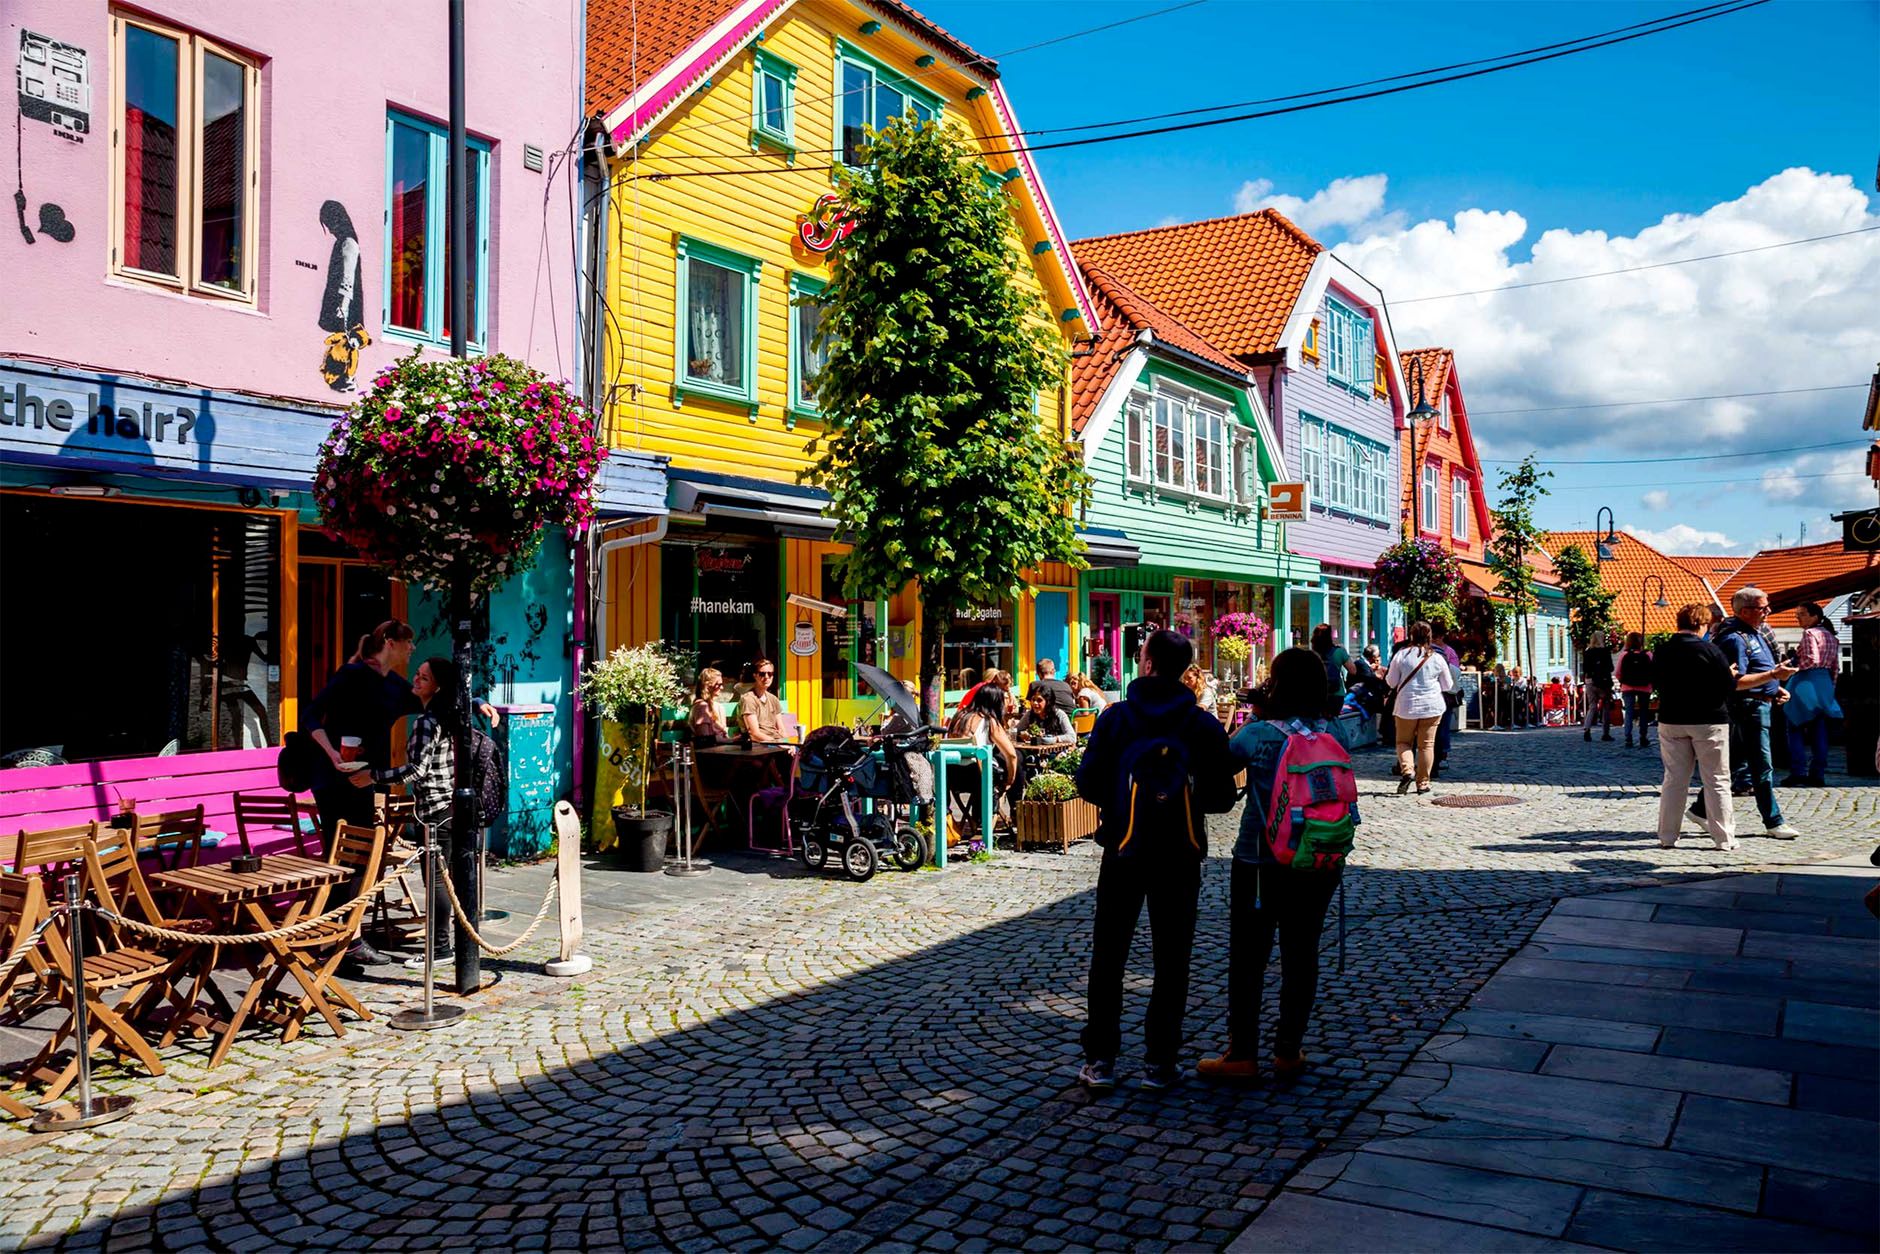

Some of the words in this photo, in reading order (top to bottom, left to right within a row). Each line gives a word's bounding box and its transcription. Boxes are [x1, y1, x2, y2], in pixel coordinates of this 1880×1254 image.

[0, 382, 74, 432] the
[88, 392, 196, 444] hair?
[690, 597, 755, 615] #hanekam
